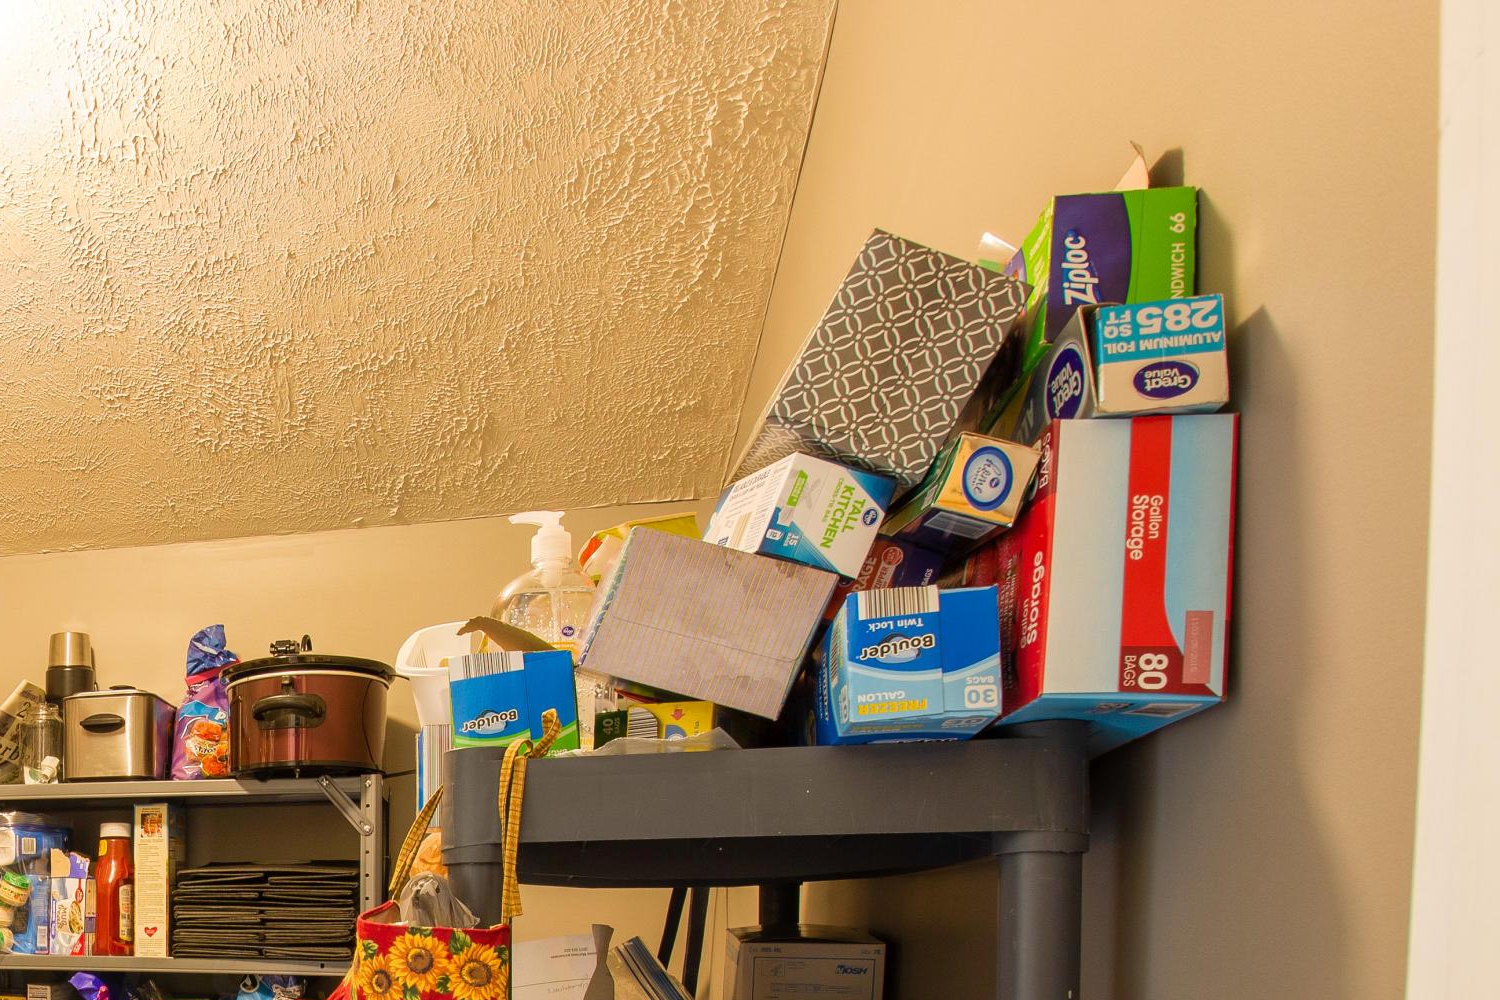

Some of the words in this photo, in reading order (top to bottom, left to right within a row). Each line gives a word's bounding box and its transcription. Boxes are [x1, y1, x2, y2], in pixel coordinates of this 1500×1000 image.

[1062, 236, 1100, 305] Ziploc
[1171, 242, 1186, 299] NDWICH
[1136, 300, 1218, 335] 285
[1103, 340, 1136, 355] FOIL
[1139, 331, 1222, 350] ALUMINUM
[1144, 375, 1192, 391] Great
[820, 484, 856, 549] KITCHEN
[842, 498, 866, 532] TALL
[1126, 494, 1150, 560] Storage
[1148, 495, 1164, 540] Gallon
[852, 557, 877, 592] RAGE
[1026, 551, 1043, 645] Storage
[868, 620, 894, 632] Lock
[896, 617, 924, 628] Twin
[859, 634, 935, 661] Boulder
[1123, 655, 1136, 687] BAGS
[1138, 652, 1170, 690] 80
[857, 699, 928, 716] FREEZER
[967, 689, 995, 703] 30
[462, 709, 518, 732] Boulder
